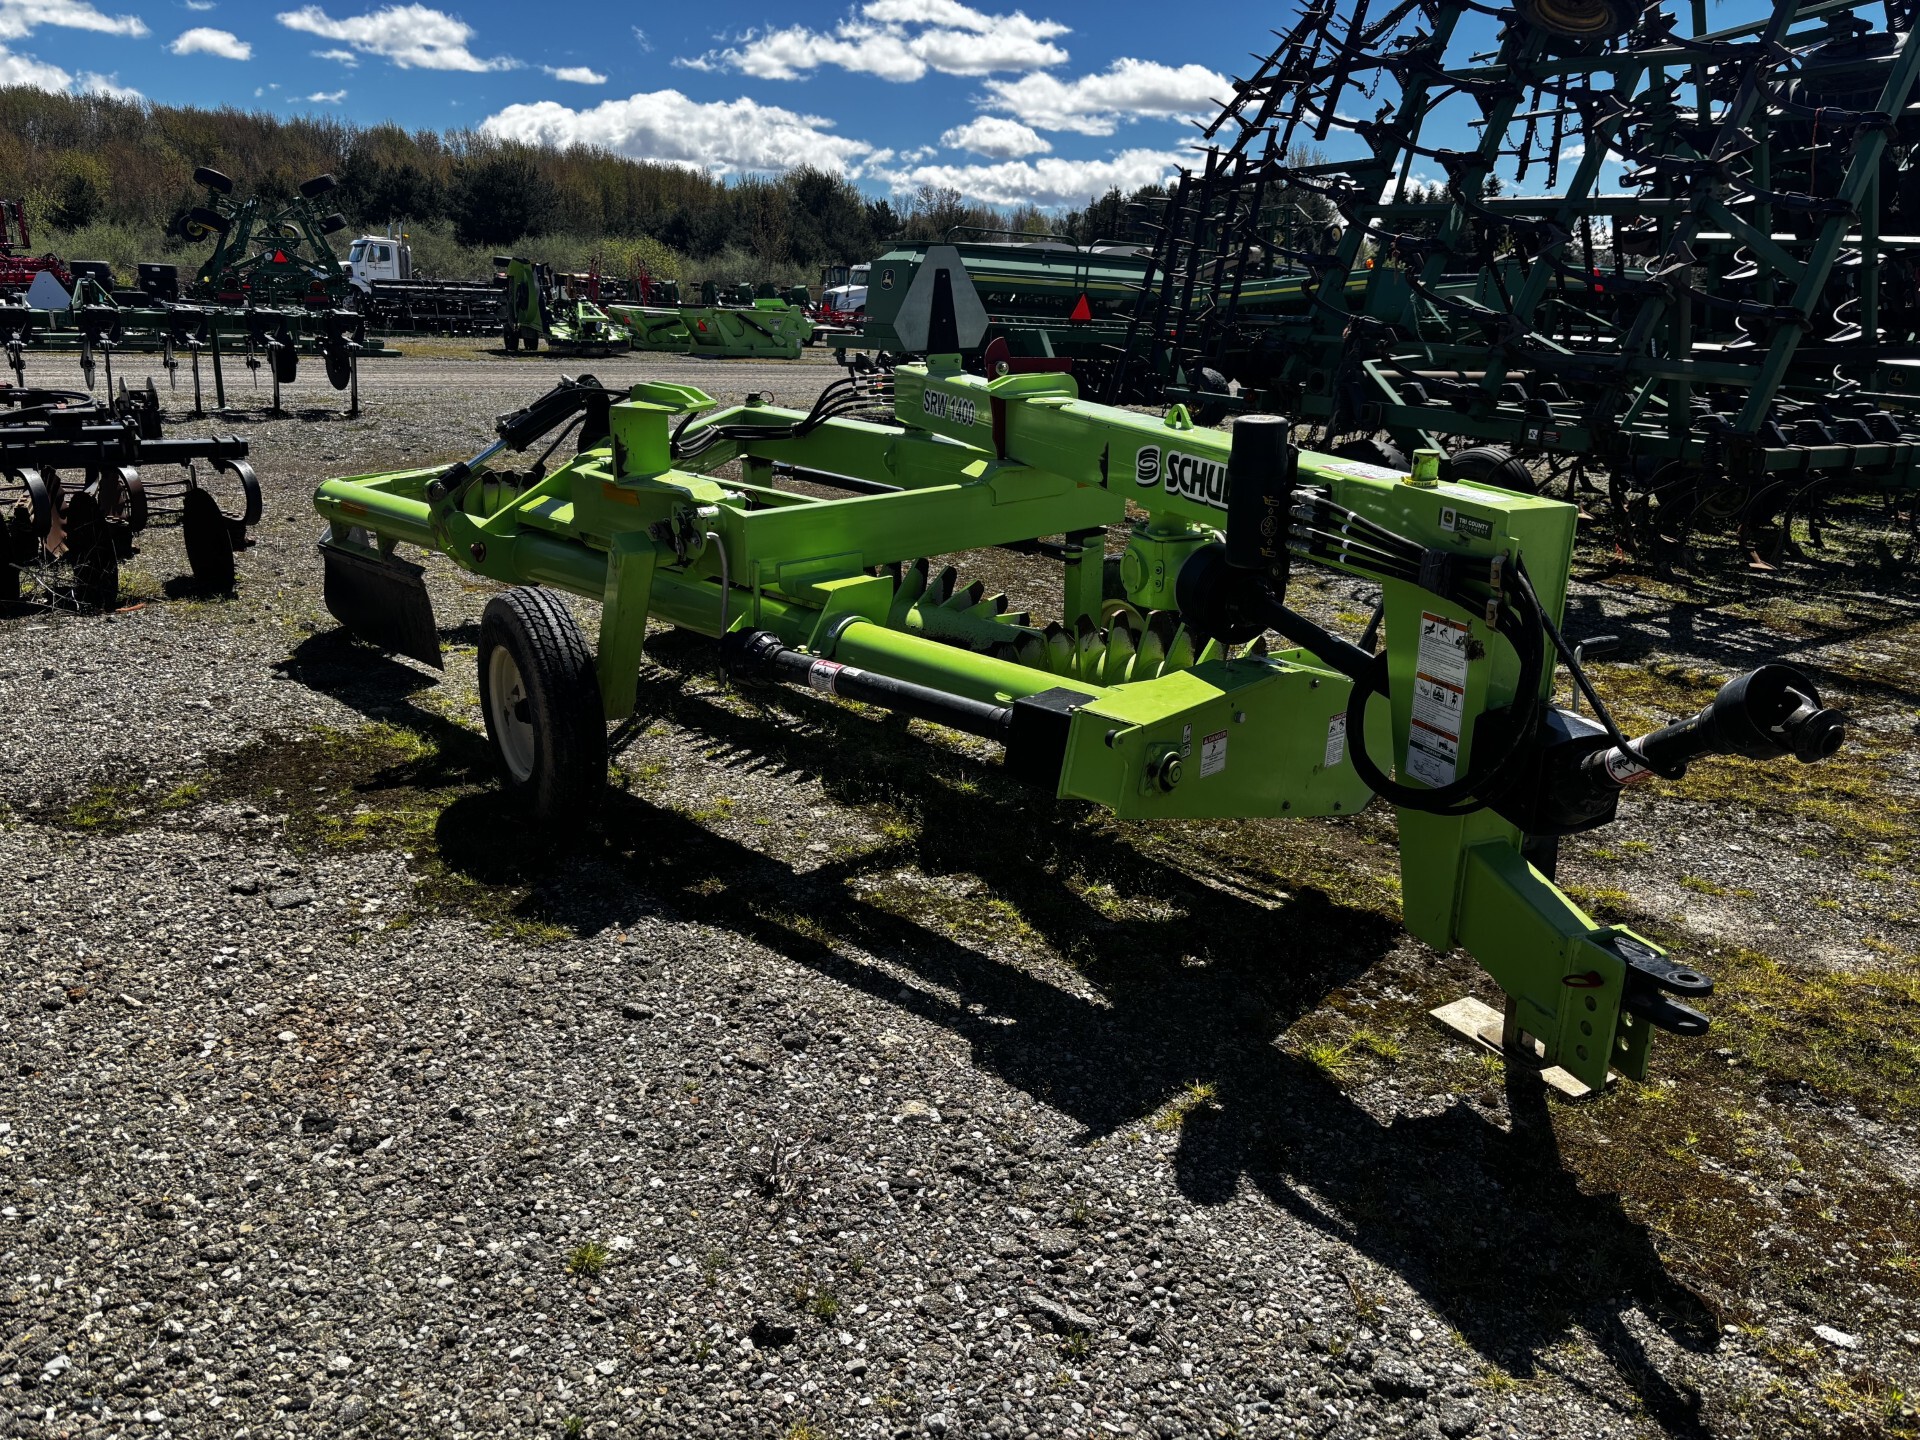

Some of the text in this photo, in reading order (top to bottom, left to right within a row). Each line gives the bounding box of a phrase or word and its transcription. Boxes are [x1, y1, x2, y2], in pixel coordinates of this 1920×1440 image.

[923, 388, 976, 427] SRW 1400
[1459, 517, 1489, 531] TRI COUNTY
